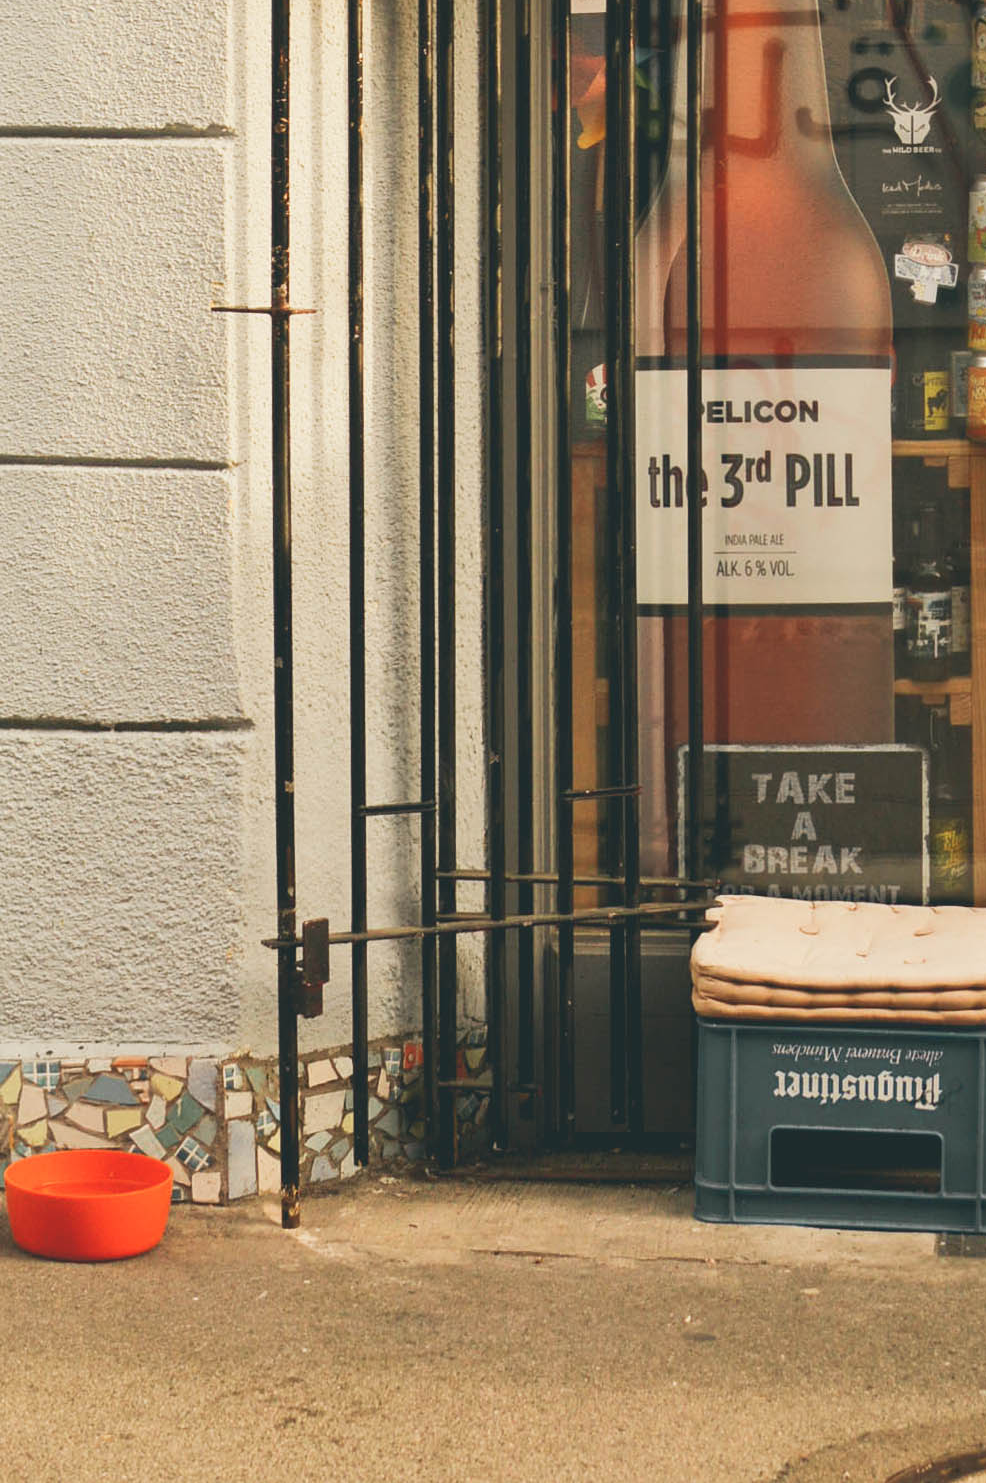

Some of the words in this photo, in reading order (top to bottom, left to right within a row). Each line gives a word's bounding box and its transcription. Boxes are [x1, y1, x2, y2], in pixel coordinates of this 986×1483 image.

[913, 146, 935, 154] BEER
[699, 399, 820, 424] ELICON
[720, 450, 772, 509] 3rd
[785, 453, 860, 508] PILL
[724, 533, 748, 547] INDIA
[748, 533, 769, 547] PALE
[769, 533, 785, 547] ALE
[715, 559, 742, 578] ALK.
[769, 559, 796, 578] VOL.
[751, 771, 857, 805] TAKE
[790, 810, 817, 841] A
[743, 843, 863, 876] BREAK
[771, 1042, 843, 1064] Münchens
[844, 1046, 902, 1065] Brauerei
[772, 1069, 943, 1112] Augustiner
